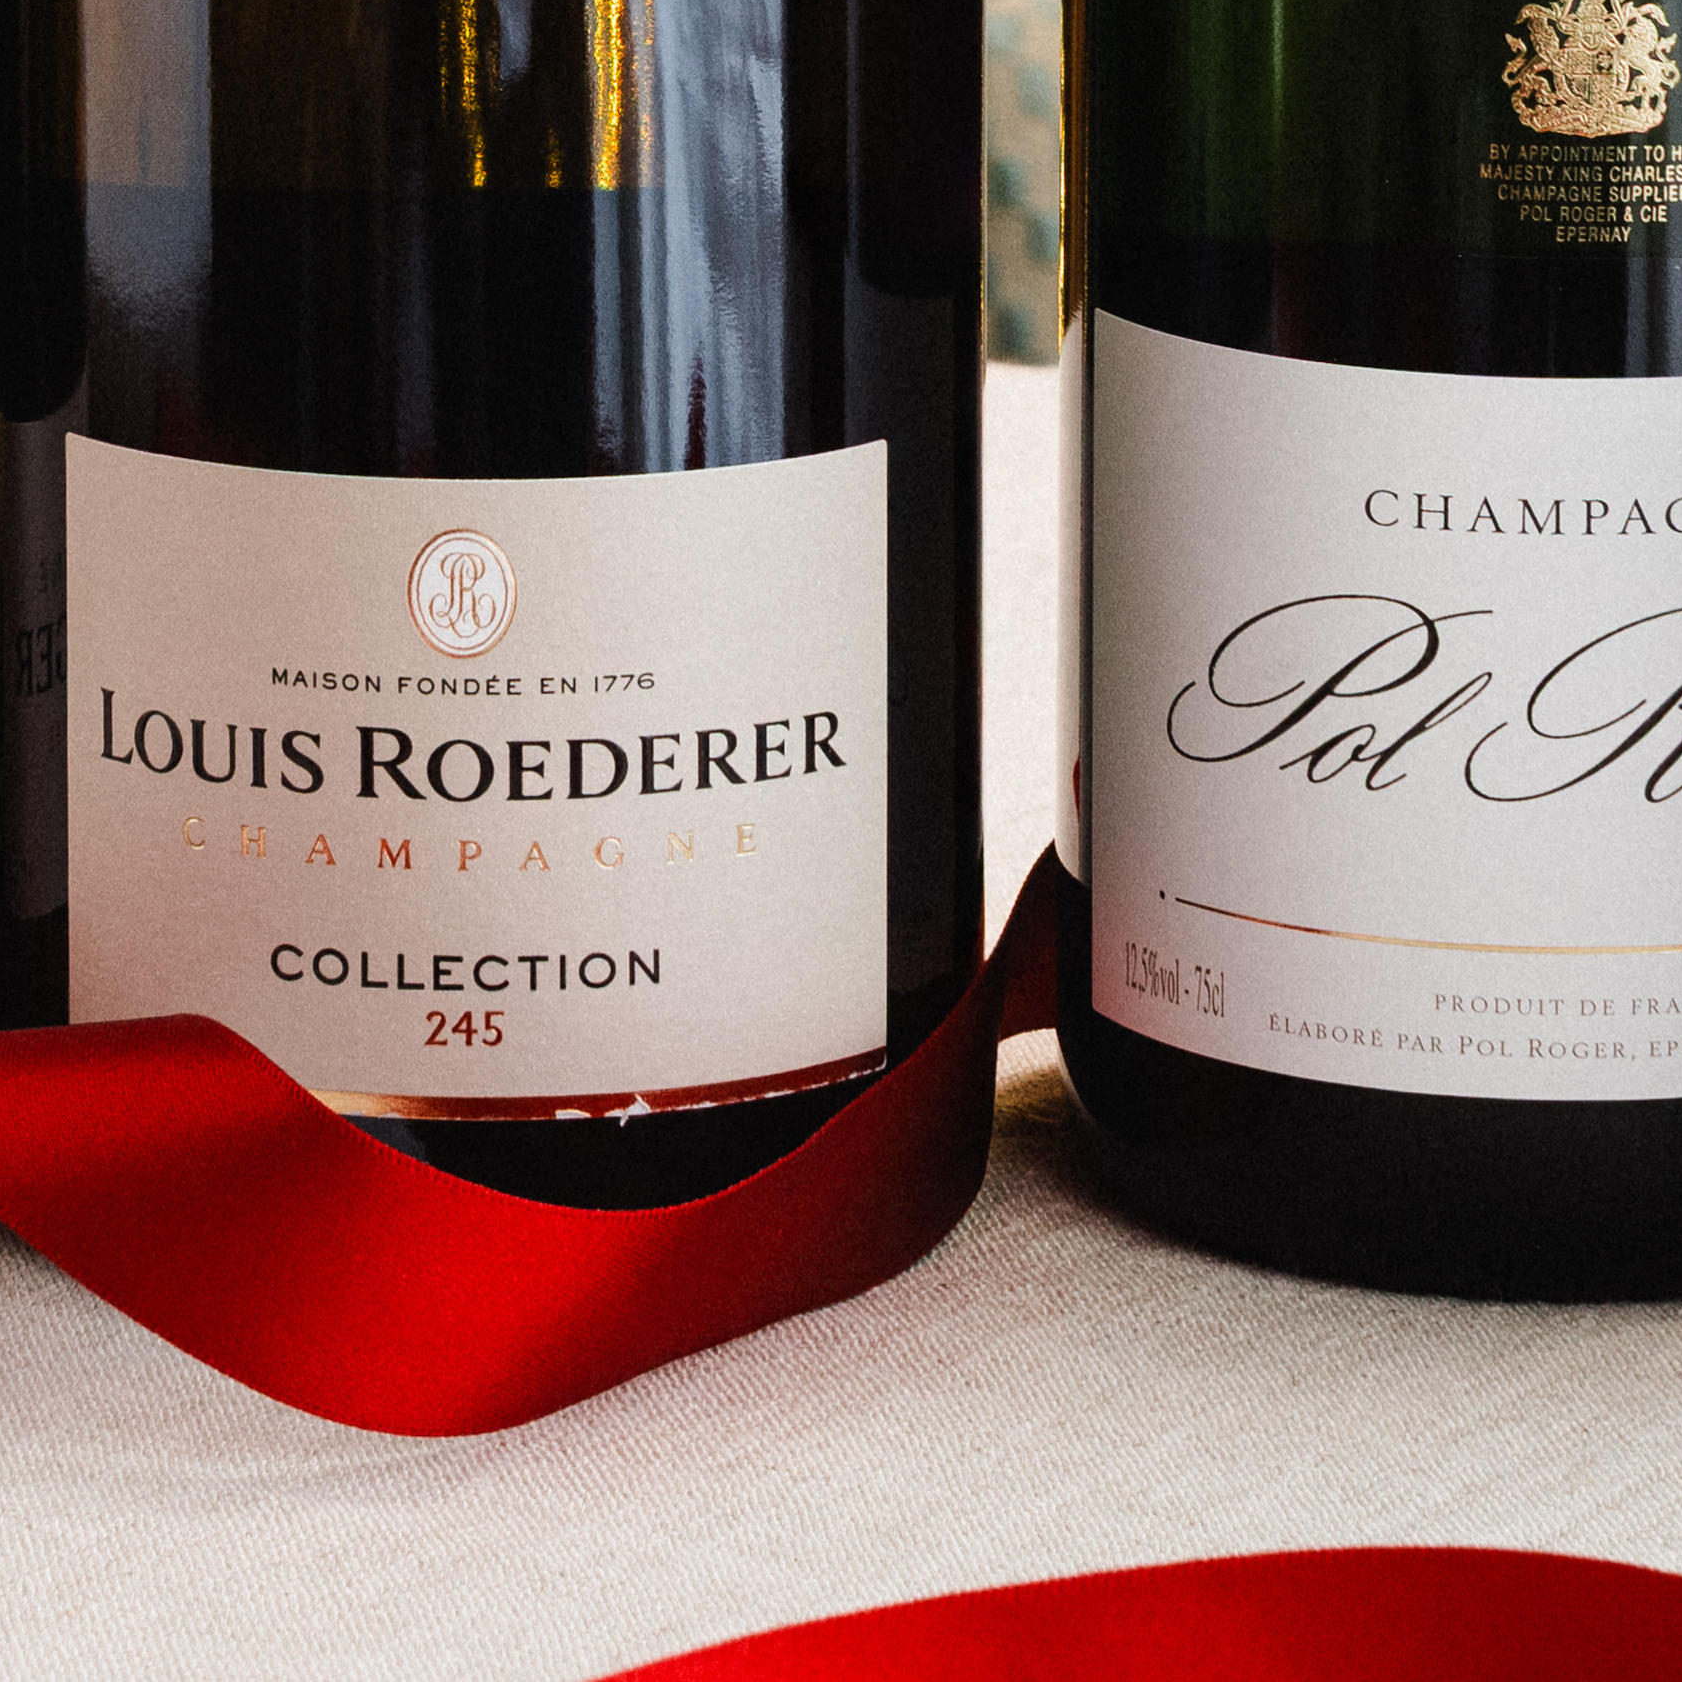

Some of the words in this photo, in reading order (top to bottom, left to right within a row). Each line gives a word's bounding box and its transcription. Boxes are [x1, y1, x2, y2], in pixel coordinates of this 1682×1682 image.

[1489, 143, 1510, 161] BY
[1518, 145, 1637, 162] APPOINTMENT
[1644, 145, 1665, 162] TO
[1480, 164, 1555, 181] MAJESTY
[1563, 165, 1602, 181] KING
[1498, 185, 1602, 202] CHAMPAGNE
[1520, 205, 1551, 222] POL
[1560, 205, 1617, 222] ROGER
[1623, 205, 1634, 222] &
[1640, 205, 1668, 222] CIE
[1556, 226, 1632, 243] EPERNAY
[271, 667, 382, 694] MAISON
[398, 673, 522, 696] FONDÉE
[540, 676, 577, 694] EN
[593, 672, 656, 693] 1776
[1167, 594, 1493, 791] Pol
[100, 687, 325, 794] LOUIS
[357, 711, 847, 803] ROEDERER
[182, 817, 758, 873] CHAMPAGNE
[271, 943, 662, 993] COLLECTION
[1195, 965, 1225, 1018] 75cl
[1434, 993, 1566, 1016] PRODUIT
[1580, 998, 1615, 1016] DE
[425, 1011, 505, 1047] 245
[1269, 1012, 1383, 1048] ÉLABORÉ
[1397, 1033, 1444, 1054] PAR
[1459, 1035, 1513, 1058] POL
[1528, 1038, 1636, 1061] ROGER,
